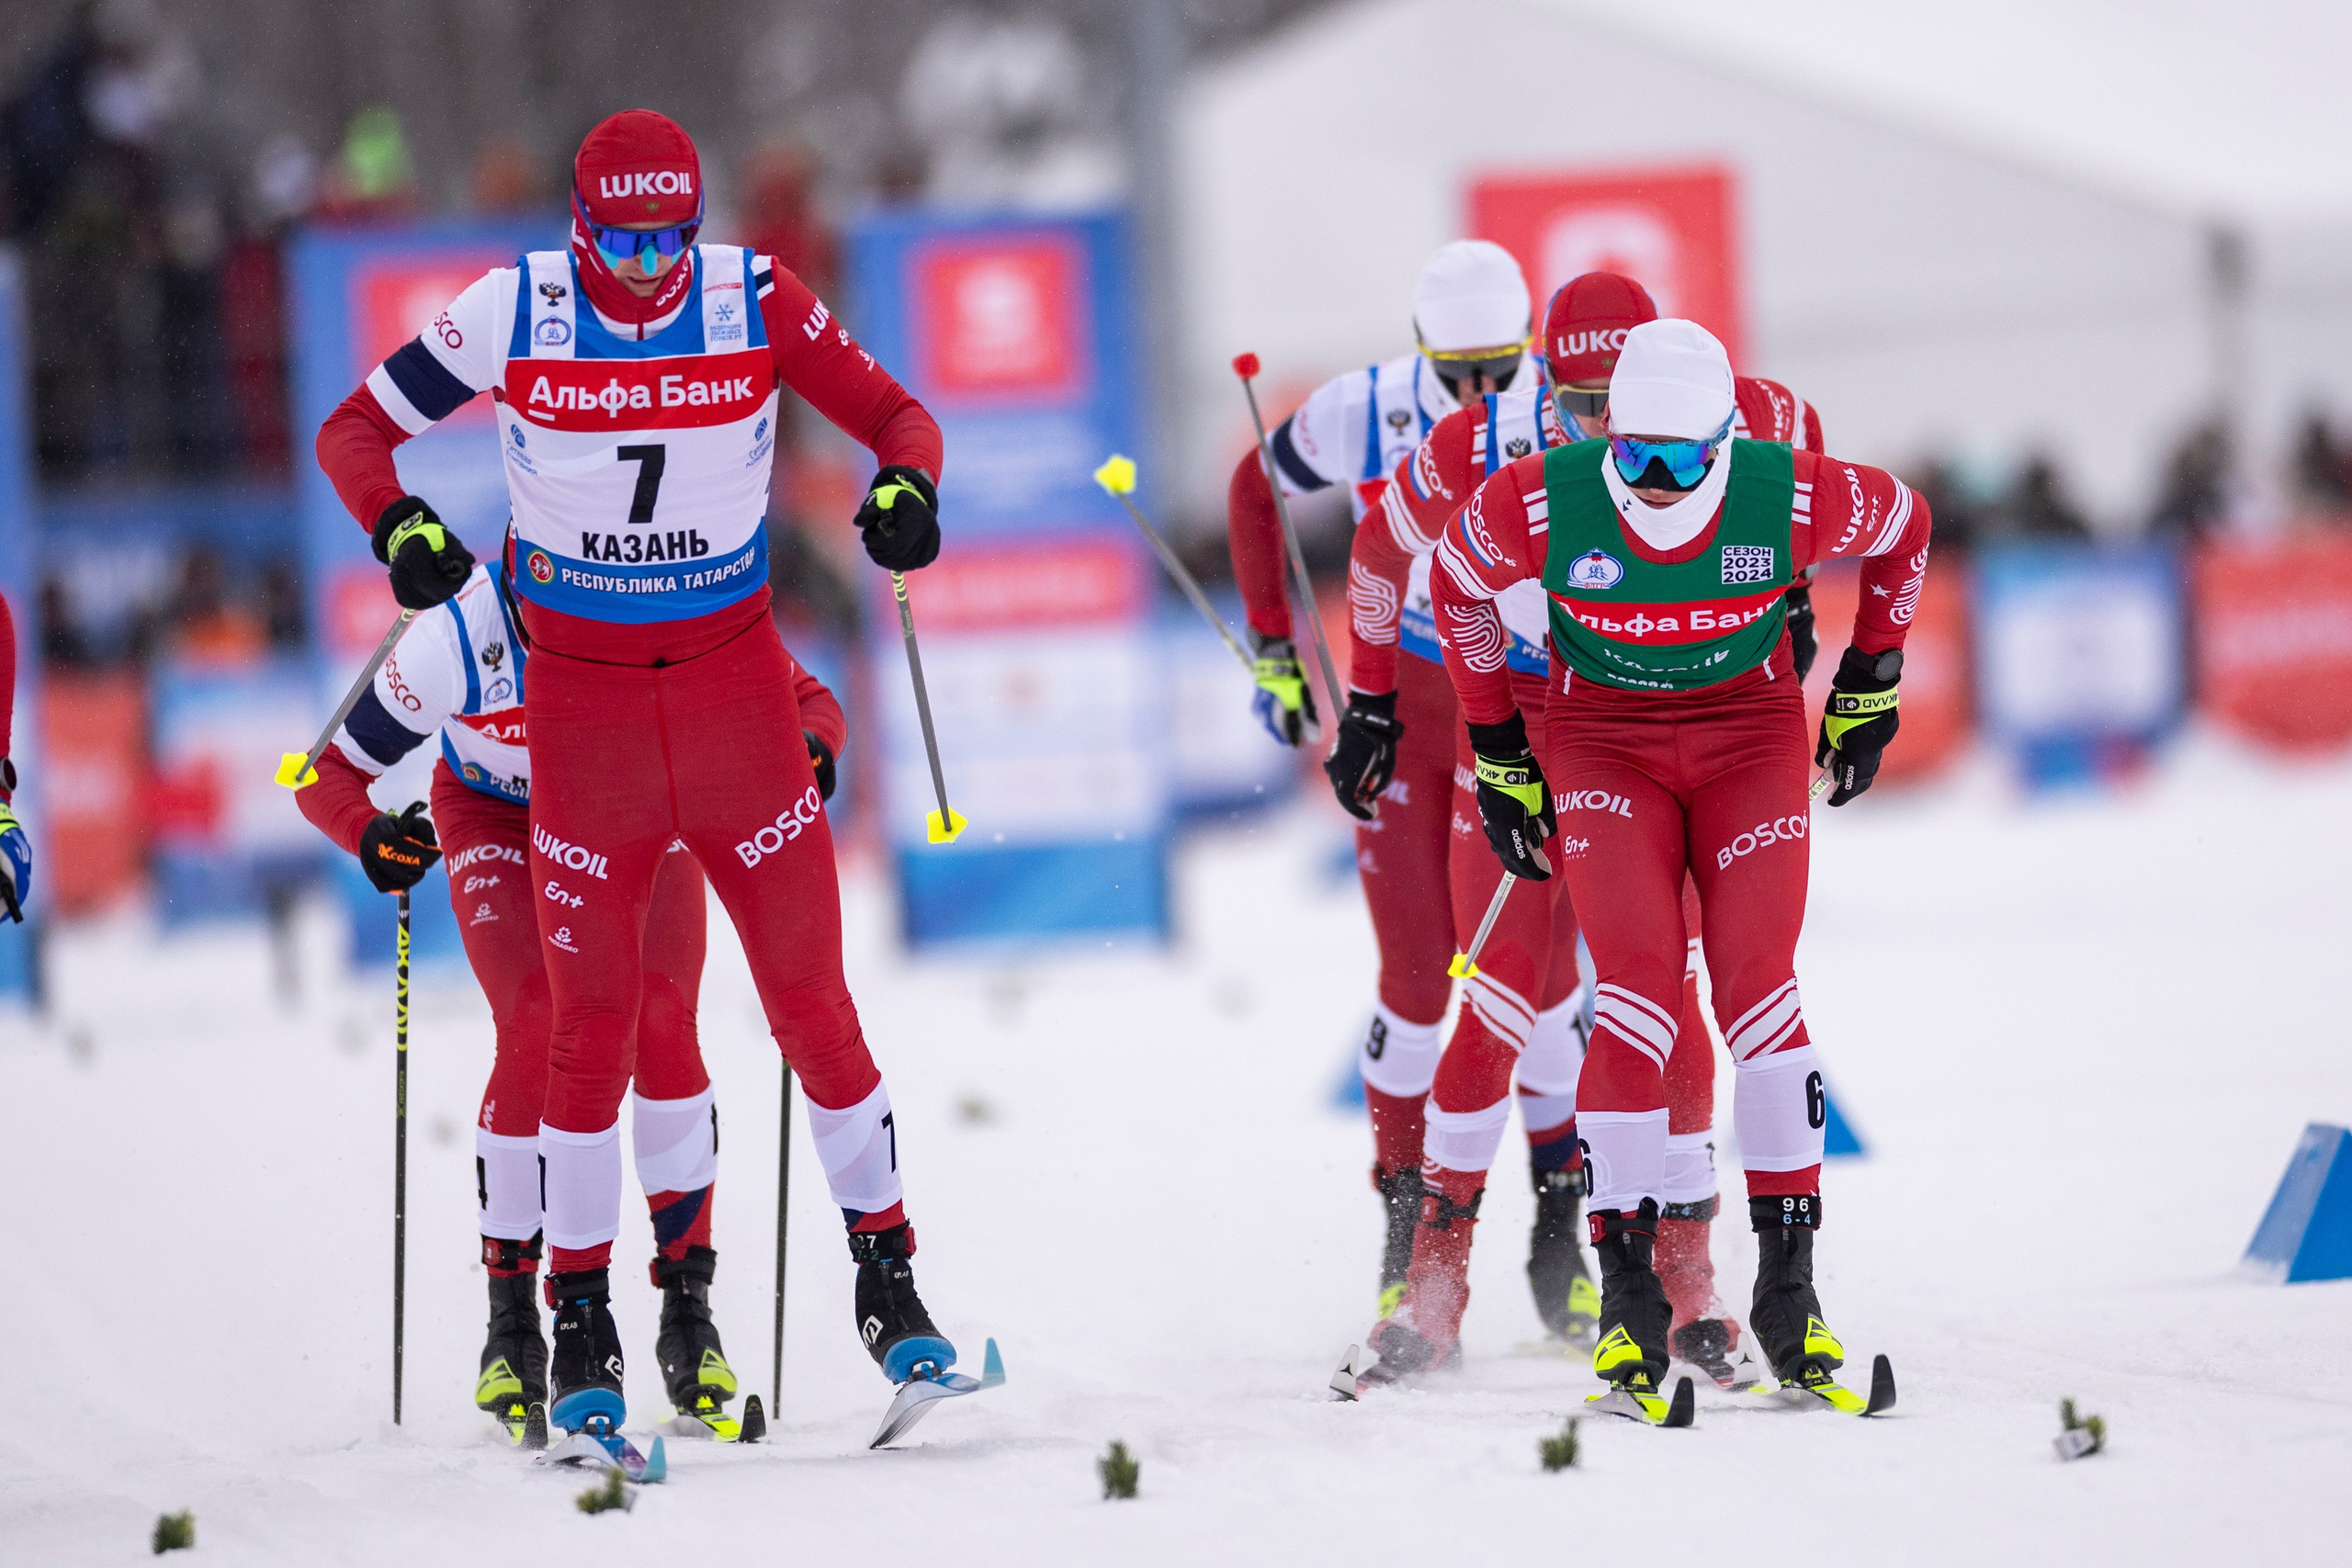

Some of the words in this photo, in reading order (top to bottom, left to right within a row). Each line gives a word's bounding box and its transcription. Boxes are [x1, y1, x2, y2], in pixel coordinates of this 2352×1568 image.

[600, 171, 692, 198] LUKOIL
[528, 376, 652, 419] Альфа
[660, 375, 753, 407] Банк
[617, 444, 666, 524] 7
[1471, 479, 1504, 561] BOSCO
[582, 529, 709, 563] КАЗАНЬ
[1723, 547, 1771, 557] СЕЗОН
[1723, 558, 1771, 570] 2023
[1723, 569, 1772, 583] 2024
[561, 568, 677, 594] РЕСПУБЛИКА
[1845, 764, 1855, 790] adidas
[1554, 789, 1634, 818] LUKOIL
[735, 785, 820, 869] BOSCO
[533, 823, 608, 880] LUKOIL
[1511, 829, 1526, 860] adidas
[1716, 814, 1806, 871] BOSCO
[449, 844, 526, 876] LUKOIL
[544, 880, 584, 908] En+
[1805, 1070, 1825, 1130] 6
[1782, 1198, 1809, 1213] 96
[1782, 1213, 1812, 1225] 6-4
